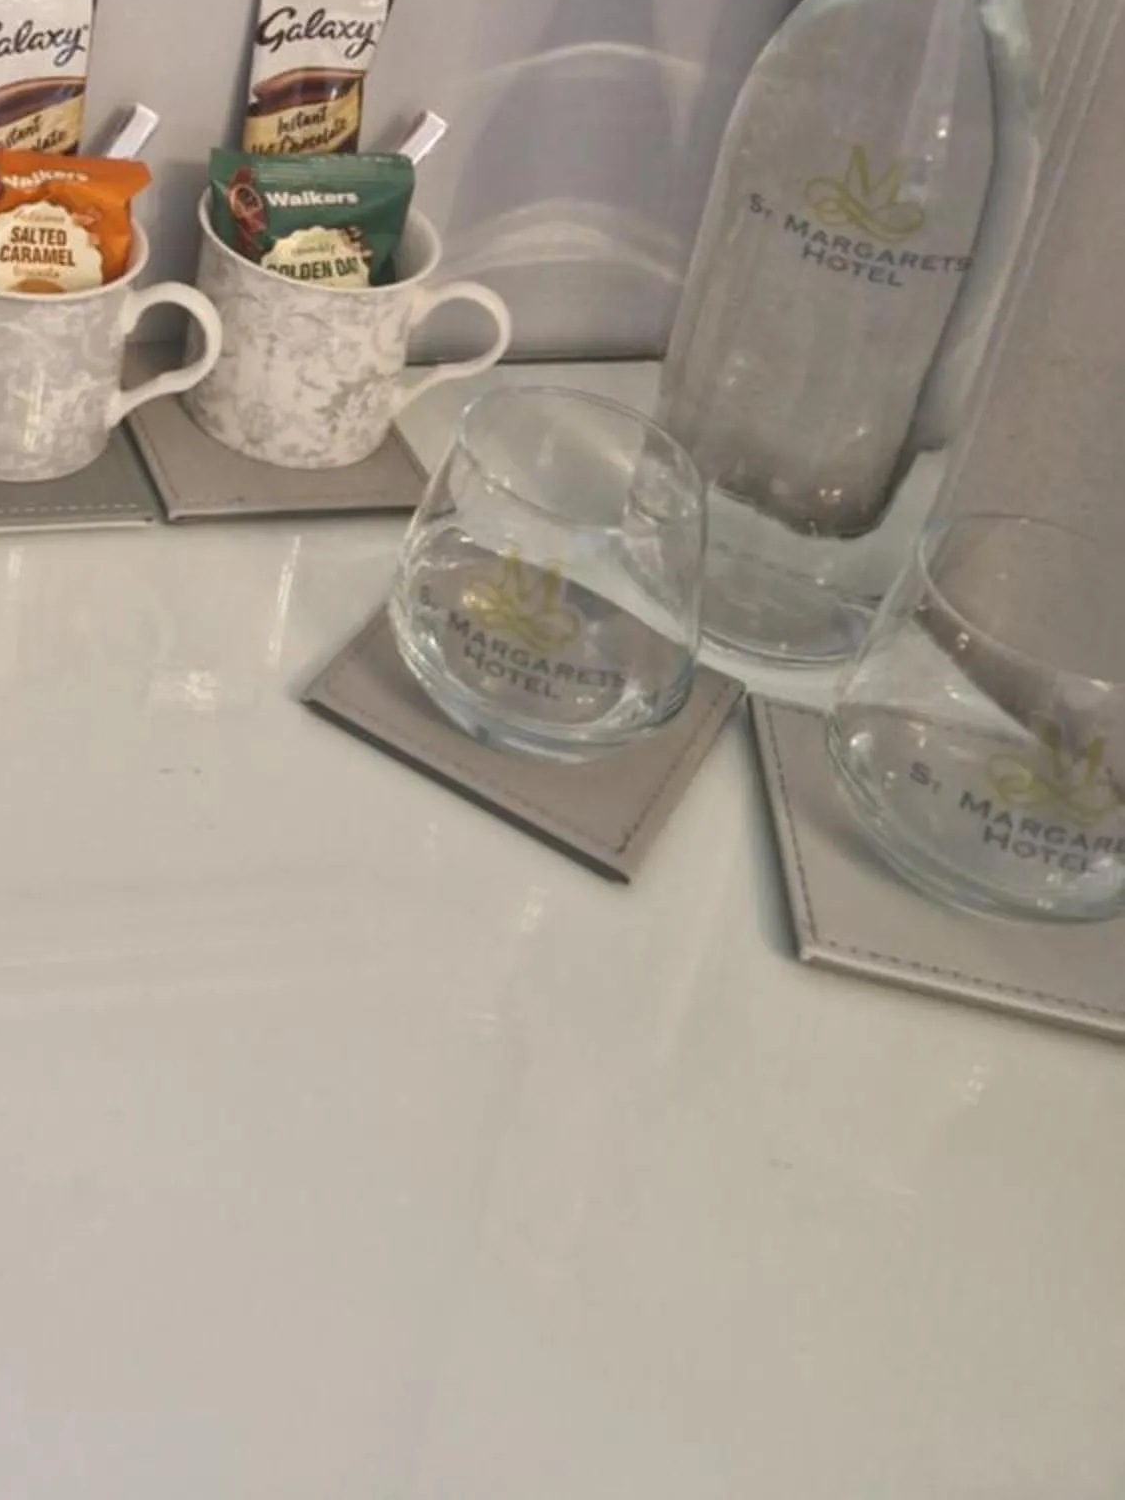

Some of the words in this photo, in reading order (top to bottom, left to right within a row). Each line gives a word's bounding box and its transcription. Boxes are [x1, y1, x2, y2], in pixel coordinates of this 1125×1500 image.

[256, 6, 377, 60] Galaxy
[0, 169, 90, 190] Walkers
[265, 190, 359, 208] Walkers
[0, 245, 76, 267] CARAMEL
[11, 226, 68, 247] SALTED
[783, 213, 974, 273] MARGARETS
[800, 241, 904, 288] HOTEL
[464, 644, 559, 700] HOTEL
[983, 825, 1099, 875] HOTEL
